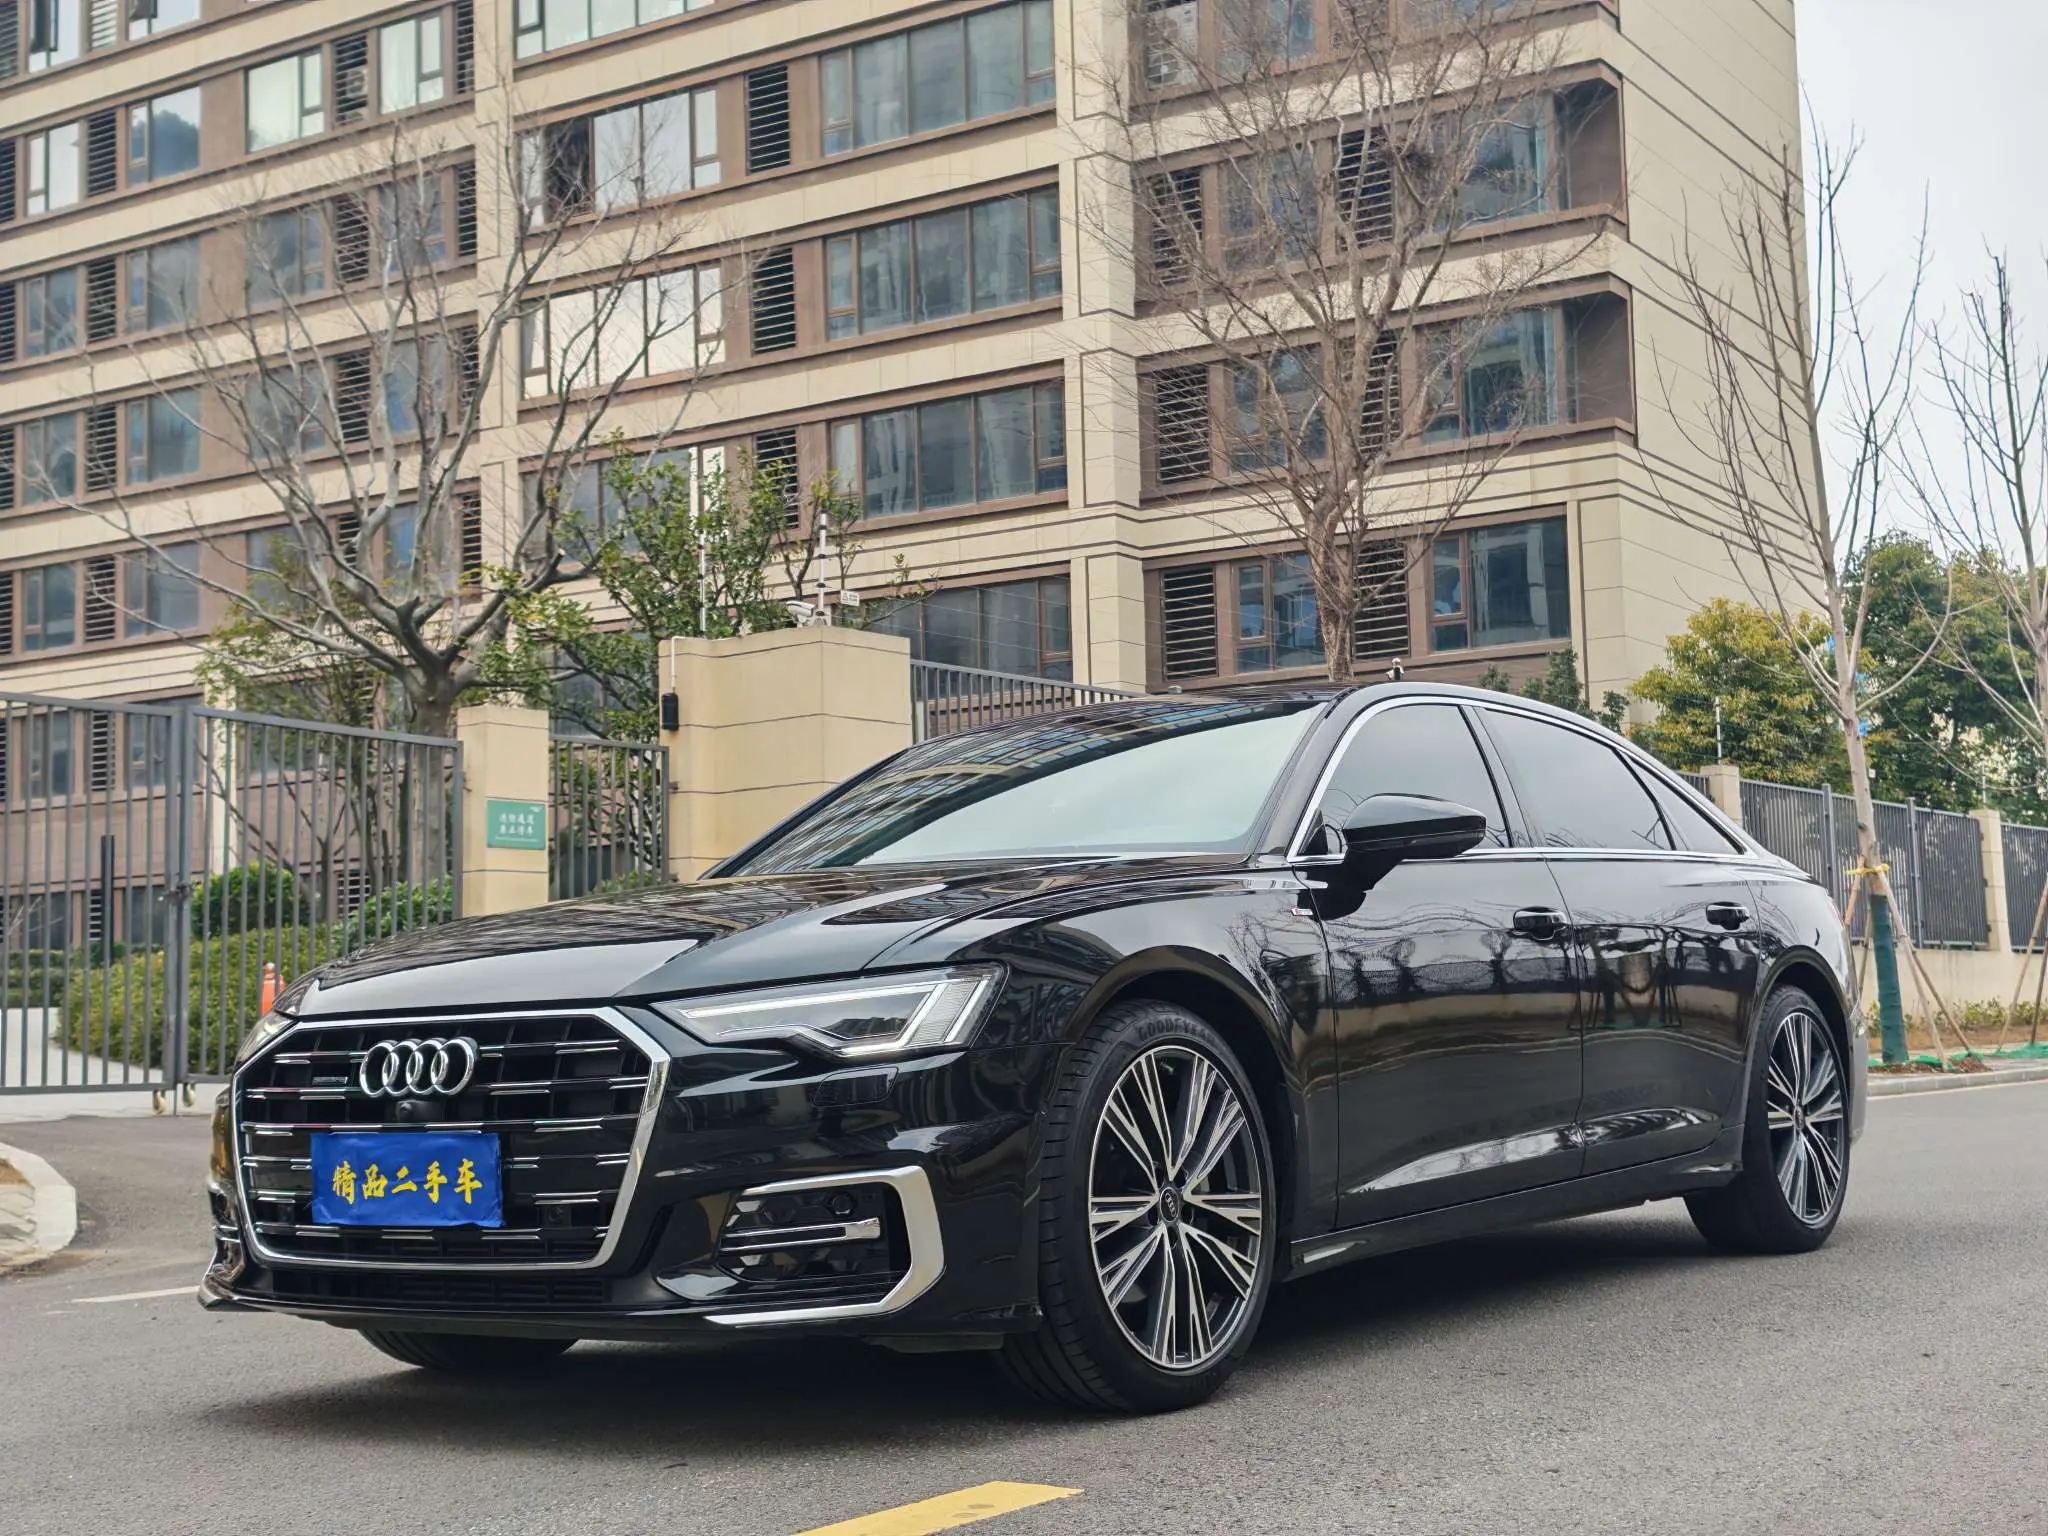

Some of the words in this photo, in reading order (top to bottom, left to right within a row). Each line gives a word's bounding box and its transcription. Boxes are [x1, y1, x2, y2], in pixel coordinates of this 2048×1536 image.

[332, 1158, 483, 1205] 精品二手车
